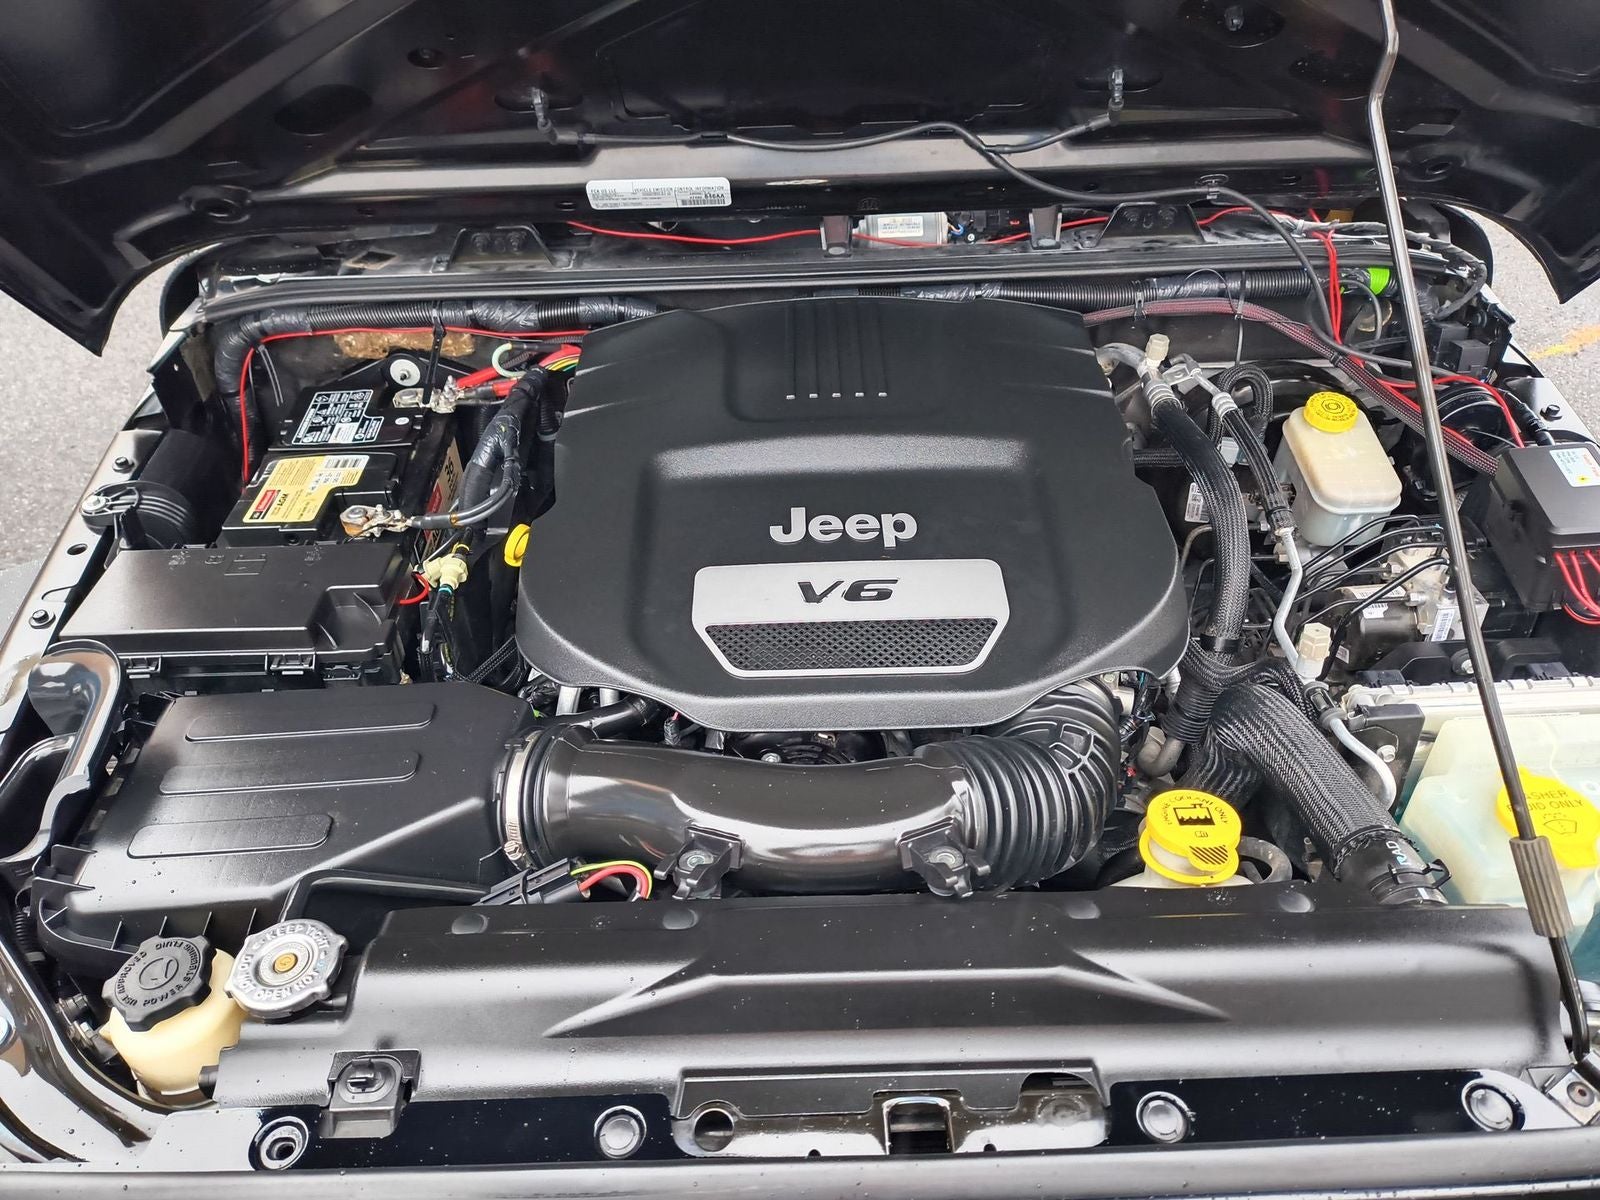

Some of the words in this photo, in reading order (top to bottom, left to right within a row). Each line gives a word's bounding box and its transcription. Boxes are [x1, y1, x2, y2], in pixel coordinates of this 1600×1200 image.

[769, 506, 918, 548] Jeep
[797, 576, 900, 604] V6
[1526, 789, 1569, 801] SHER
[1549, 799, 1584, 810] ONLY
[1170, 795, 1214, 806] COOLANT
[1214, 806, 1229, 824] ONLY
[1385, 840, 1412, 866] RAD
[155, 940, 185, 951] FLUID
[265, 923, 306, 942] KEEP
[304, 924, 330, 950] TIGHT
[116, 950, 148, 995] APPROVED
[182, 943, 199, 983] STEERING
[238, 953, 254, 971] DO
[253, 986, 293, 1000] OPEN
[293, 967, 320, 992] HOT
[121, 995, 139, 1007] USE
[142, 983, 184, 1007] POWER
